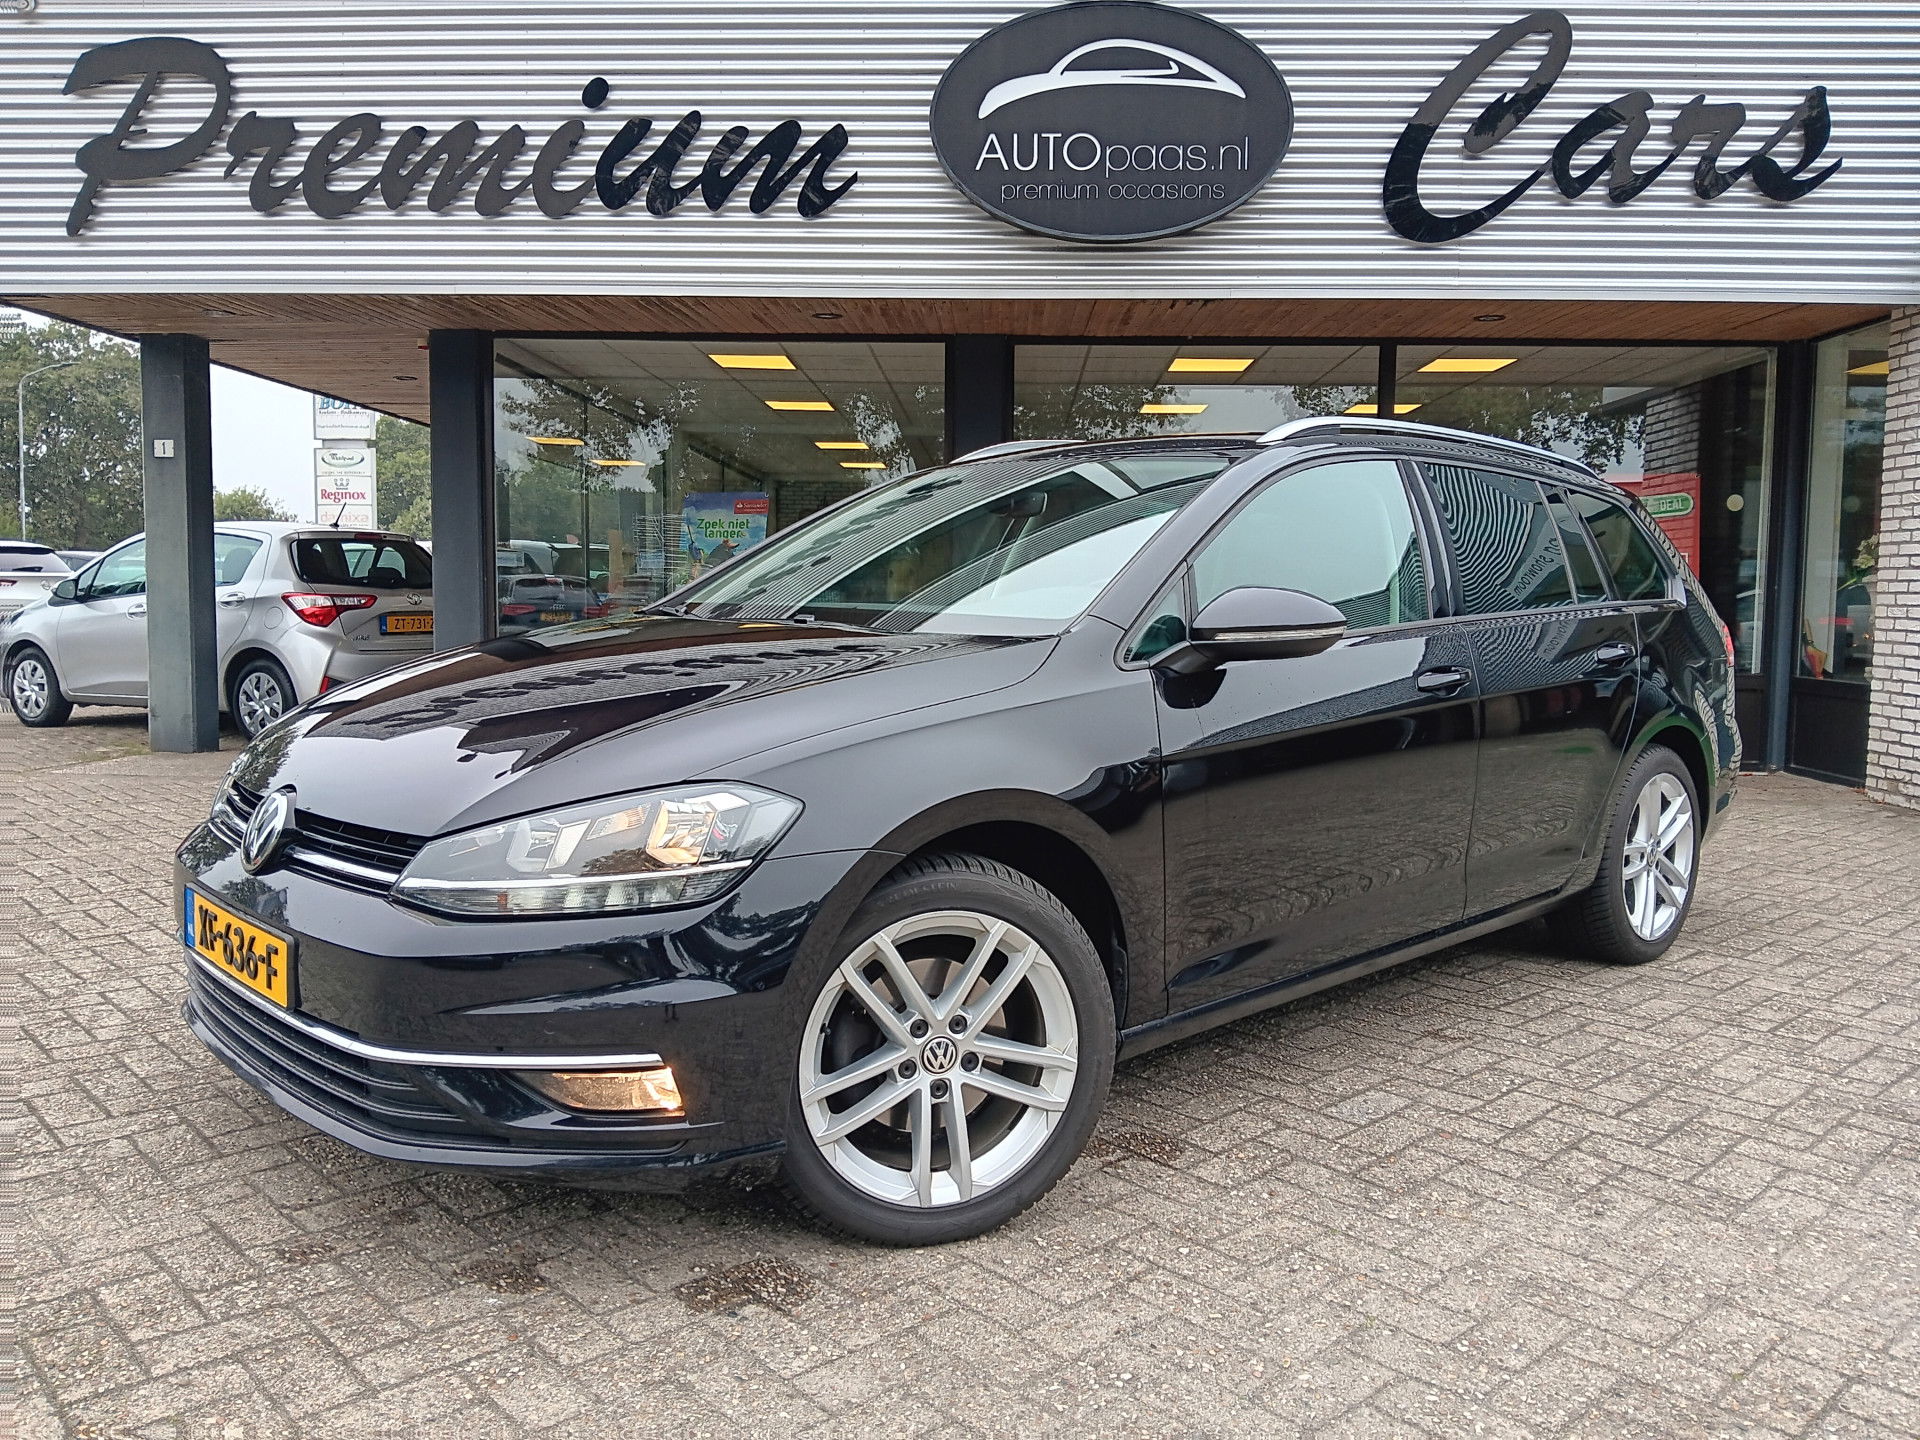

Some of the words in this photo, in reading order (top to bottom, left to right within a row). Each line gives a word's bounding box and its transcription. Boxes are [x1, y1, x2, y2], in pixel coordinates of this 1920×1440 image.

[62, 36, 857, 237] Premium
[1383, 9, 1843, 243] Cars
[976, 133, 1249, 178] AUTOpaas.nl
[1001, 180, 1099, 203] premium
[1108, 180, 1225, 200] occasions
[162, 441, 166, 455] 1
[320, 489, 367, 503] Reginox
[1660, 498, 1684, 510] DEAL
[728, 518, 750, 529] niet
[198, 904, 279, 990] XF-636-F
